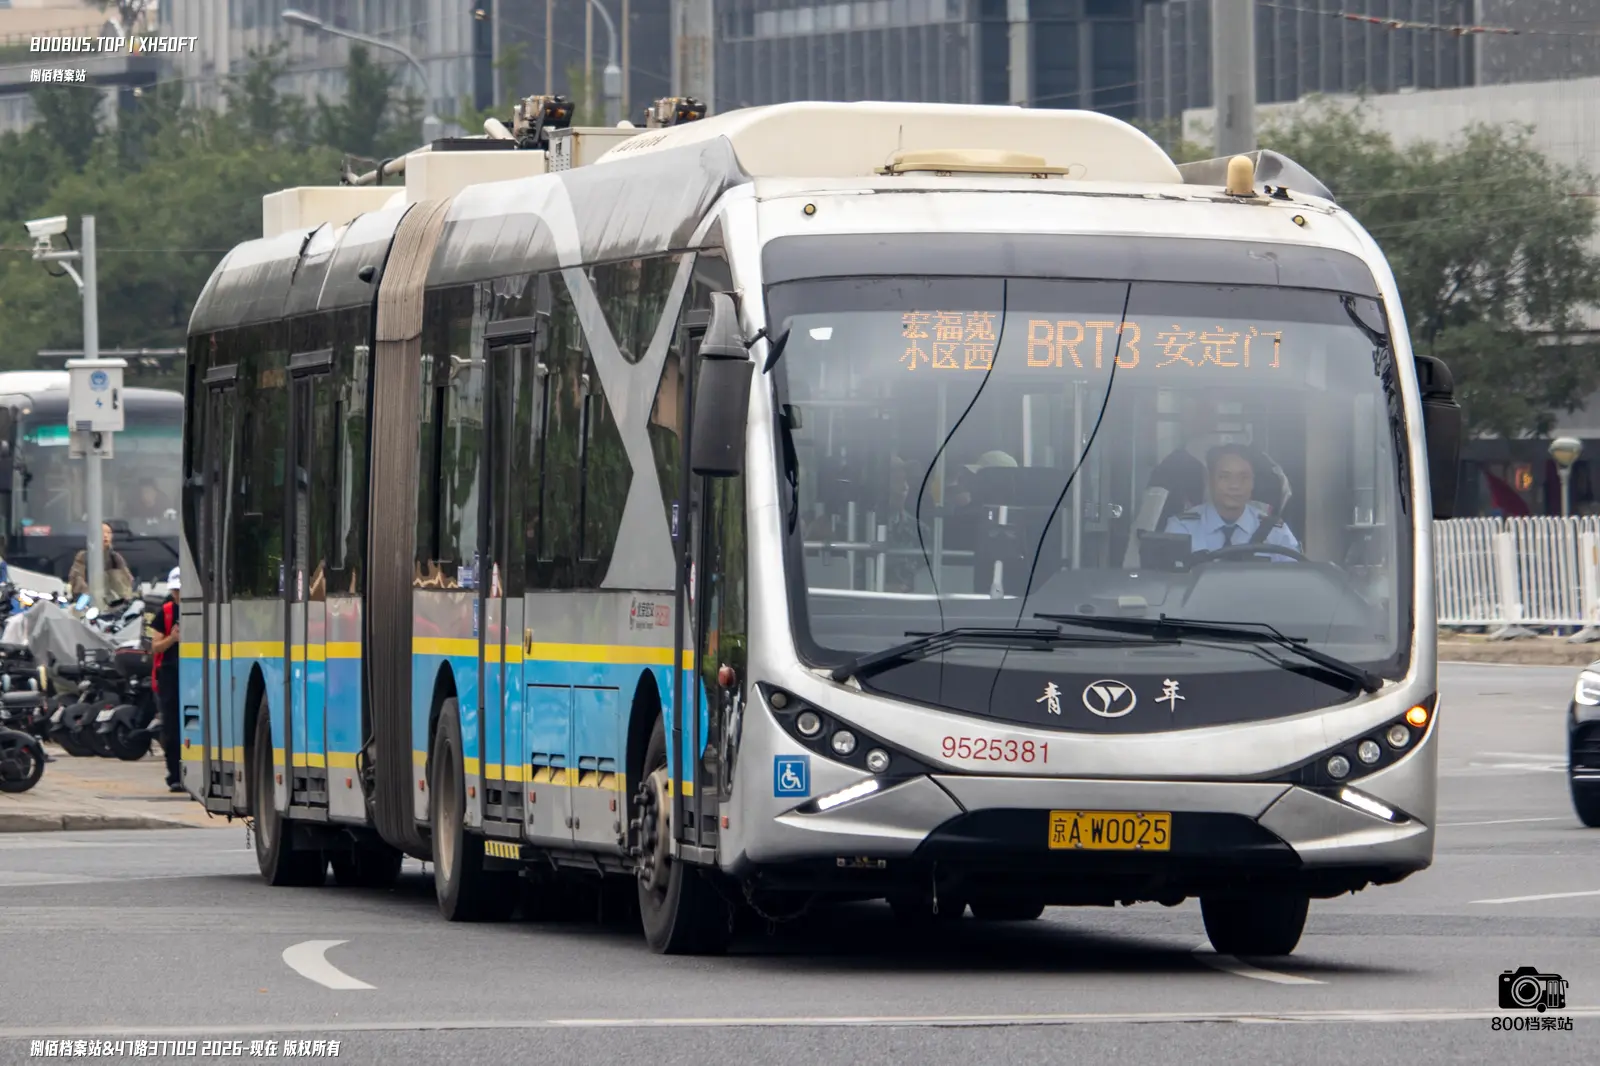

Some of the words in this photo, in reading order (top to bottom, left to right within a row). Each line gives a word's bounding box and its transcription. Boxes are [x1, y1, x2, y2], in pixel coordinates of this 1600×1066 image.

[899, 340, 994, 371] 小区西
[1027, 319, 1141, 370] BRT3
[1154, 324, 1284, 368] 安定门
[942, 736, 1049, 764] 9525381
